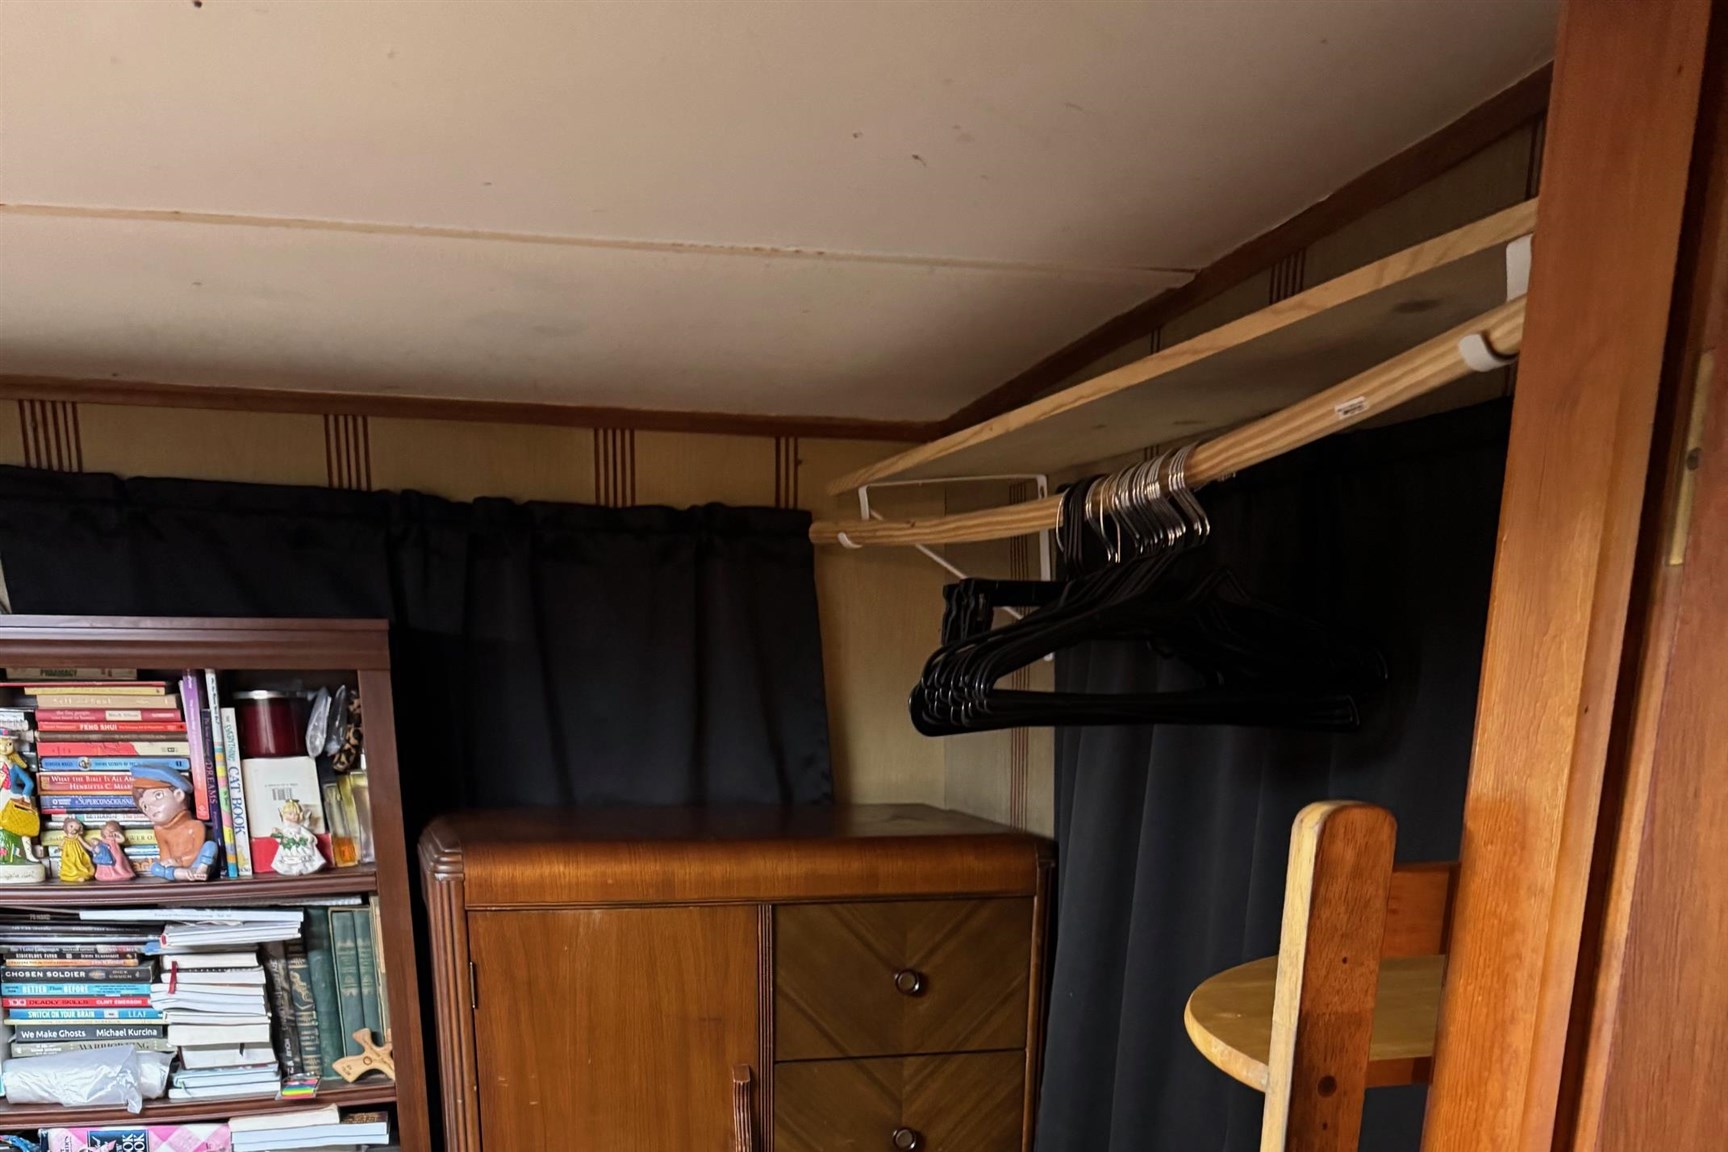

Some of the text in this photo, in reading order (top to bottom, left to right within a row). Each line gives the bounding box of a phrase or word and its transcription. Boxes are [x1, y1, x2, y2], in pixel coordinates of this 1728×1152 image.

[205, 762, 218, 805] DREAMS
[228, 766, 241, 793] CAT
[232, 797, 247, 835] BOOK
[8, 999, 27, 1007] 100
[21, 1028, 158, 1039] We Make Ghosts Michael Kurcina
